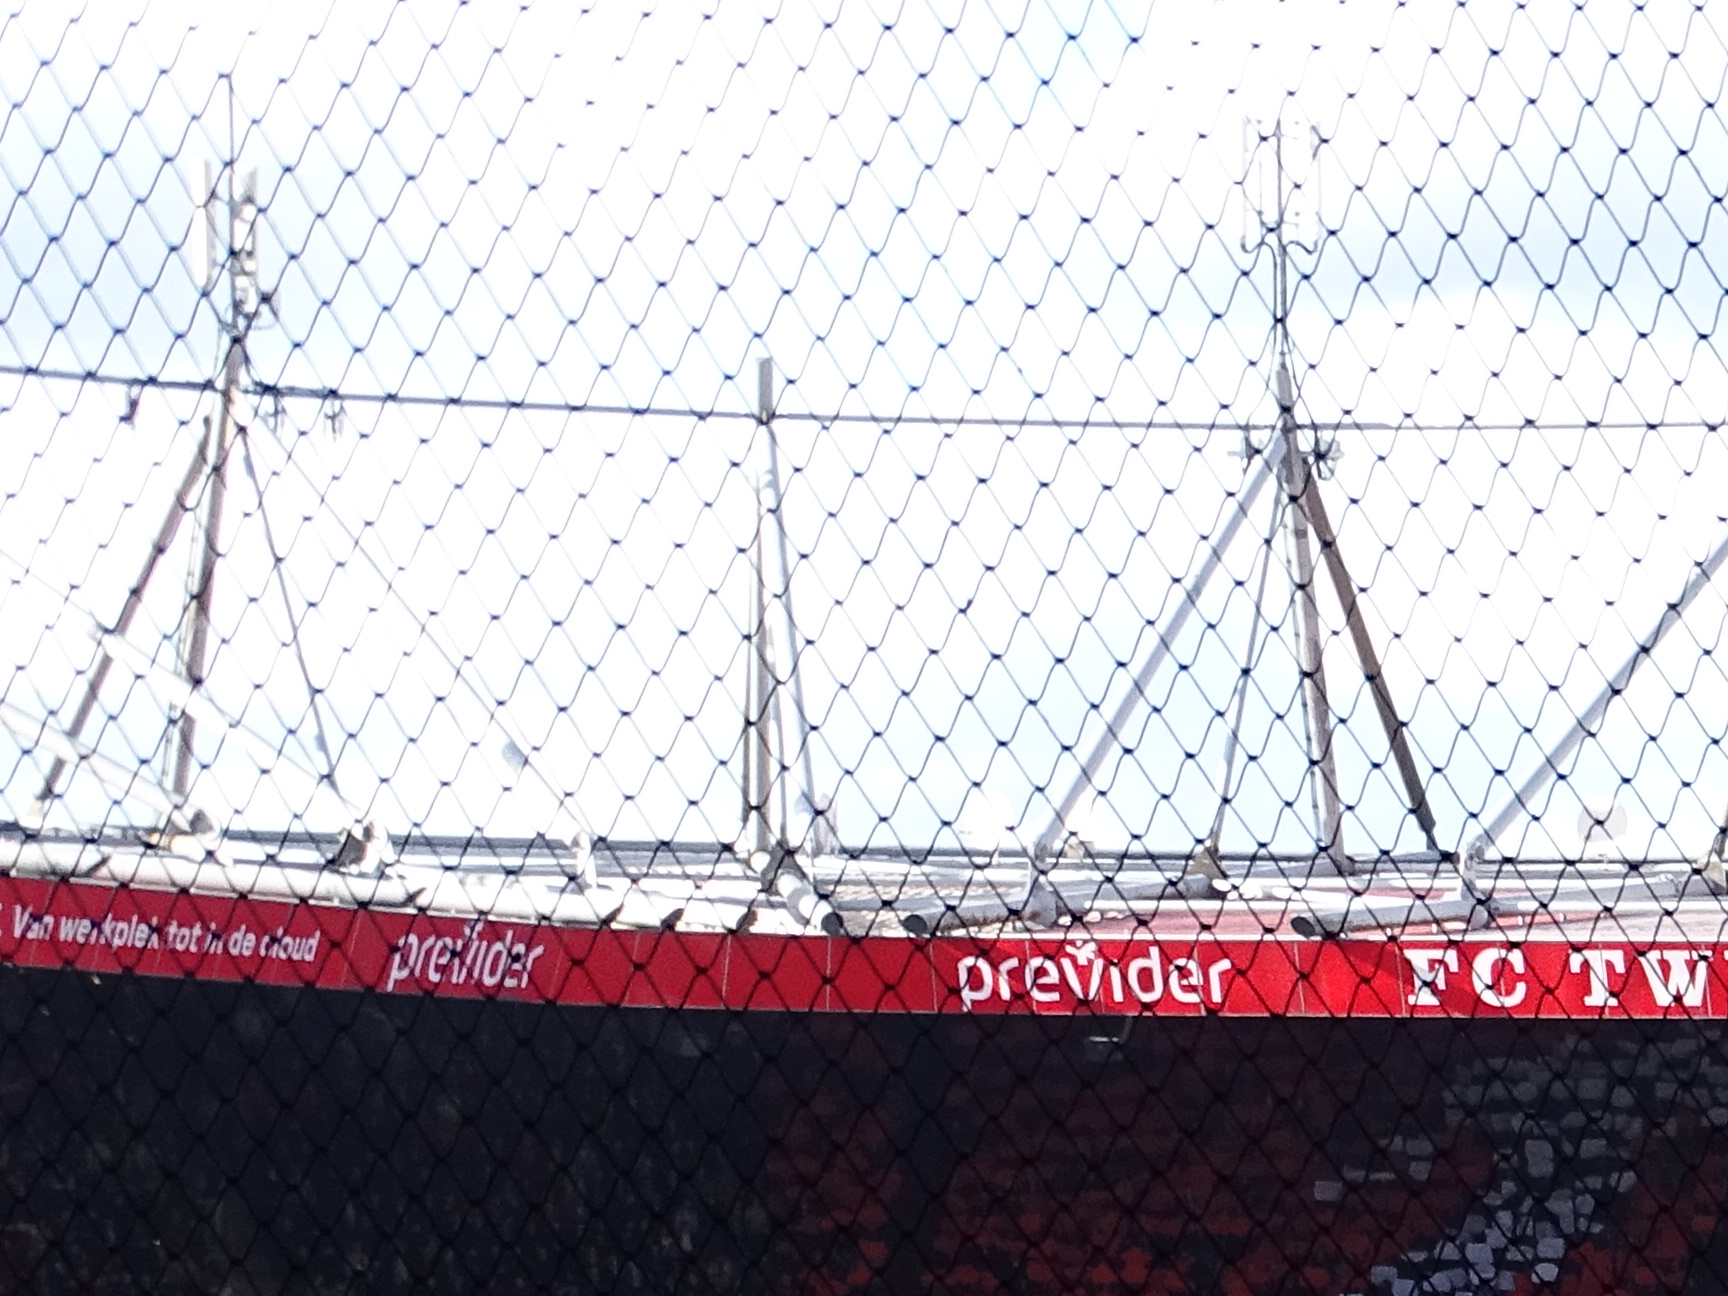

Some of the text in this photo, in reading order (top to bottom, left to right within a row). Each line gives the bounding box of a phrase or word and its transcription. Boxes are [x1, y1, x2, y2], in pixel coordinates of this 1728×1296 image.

[13, 904, 50, 939] Van
[167, 920, 202, 952] tot
[228, 924, 257, 957] de
[388, 920, 544, 992] previder
[957, 940, 1232, 1012] previder
[1407, 948, 1527, 1007] FC
